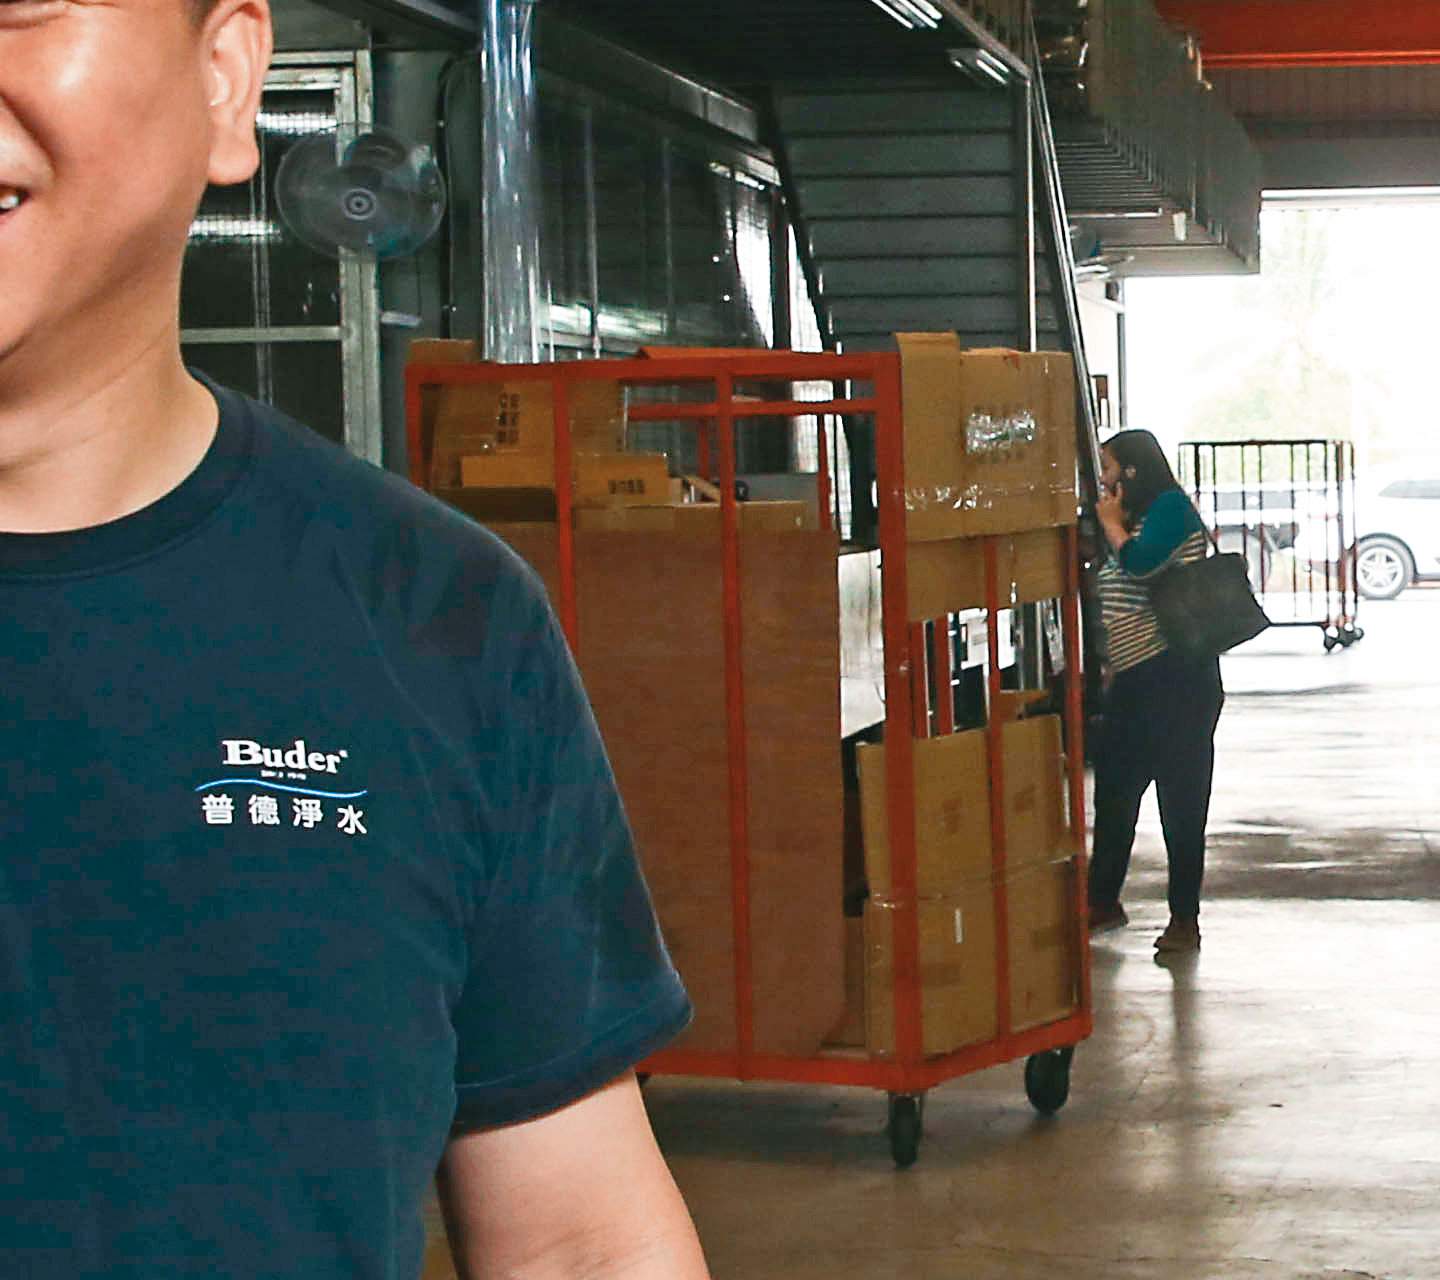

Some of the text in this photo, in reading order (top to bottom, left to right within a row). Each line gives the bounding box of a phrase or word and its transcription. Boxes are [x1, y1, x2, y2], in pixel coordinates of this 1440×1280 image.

[221, 739, 344, 773] Buder
[202, 793, 368, 835] 普德淨水
